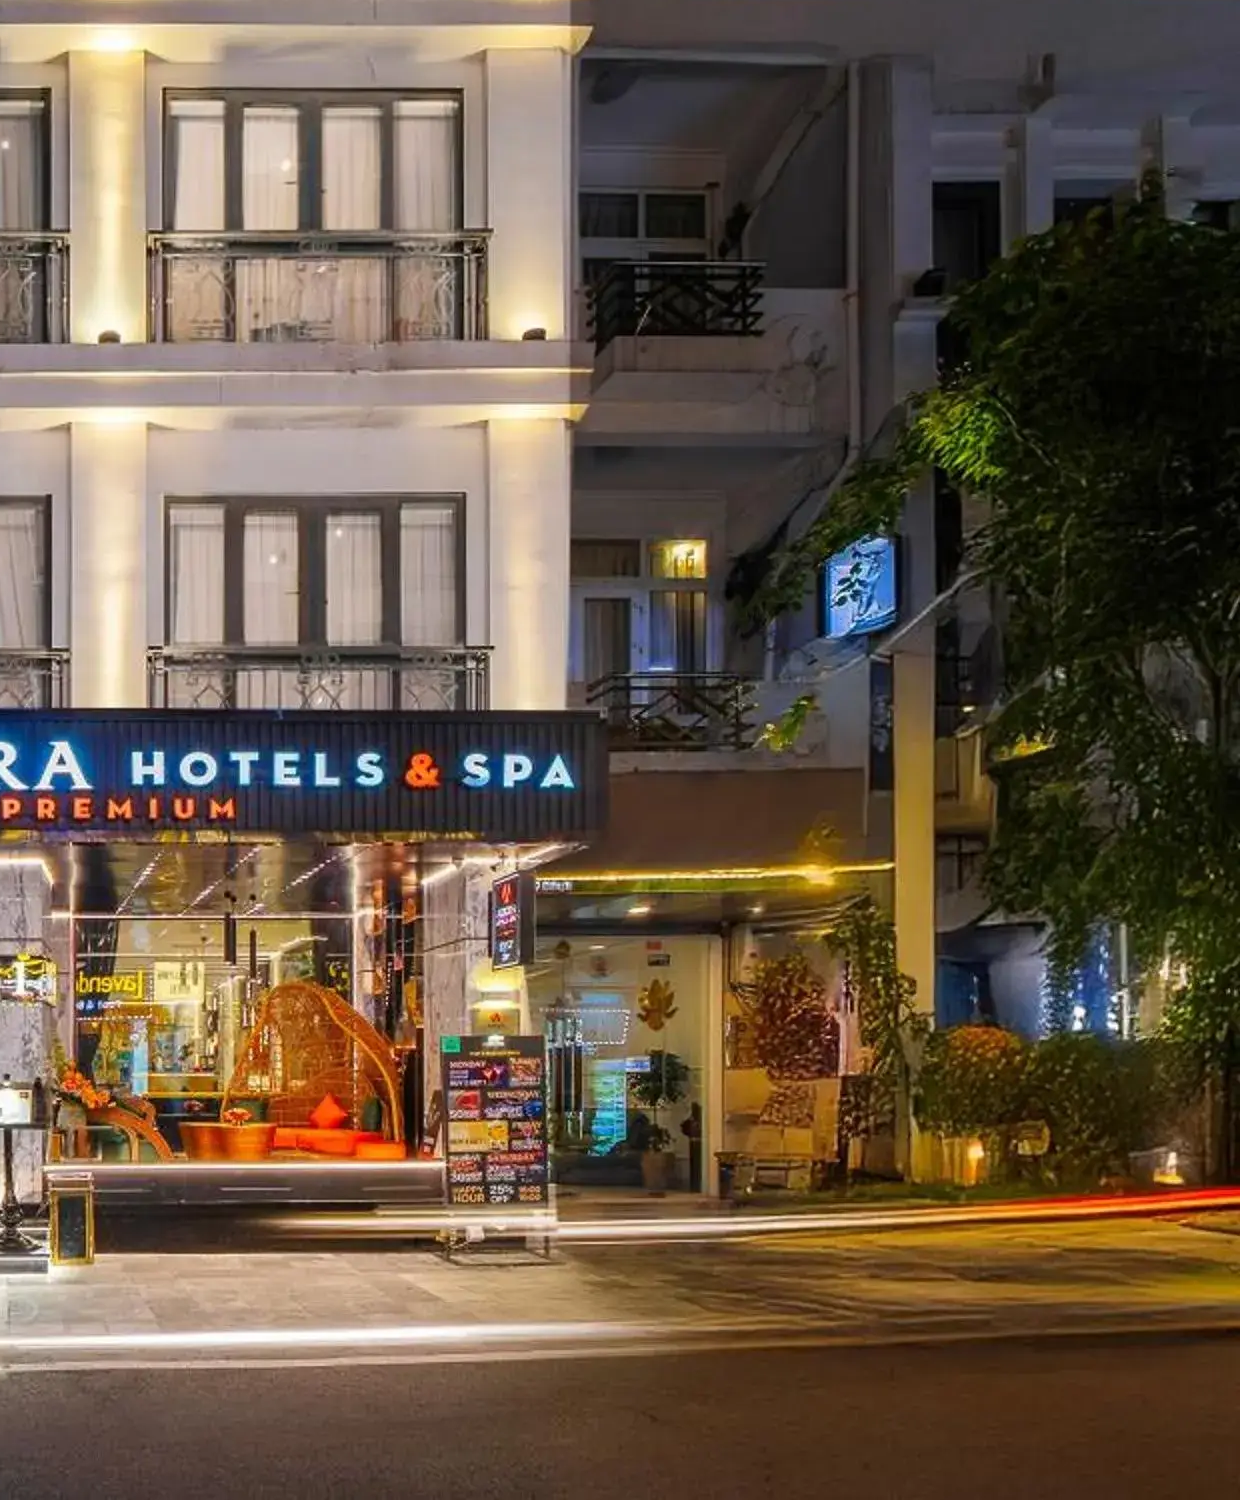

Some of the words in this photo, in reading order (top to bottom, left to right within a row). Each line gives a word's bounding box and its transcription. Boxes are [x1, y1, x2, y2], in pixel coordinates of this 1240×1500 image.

[131, 751, 384, 786] HOTELS
[405, 753, 439, 787] &
[463, 753, 575, 788] SPA
[2, 798, 236, 820] PREMIUM
[452, 1185, 485, 1194] HAPPY
[489, 1184, 515, 1195] 25%
[453, 1193, 486, 1204] HOUR
[489, 1194, 510, 1204] OFF
